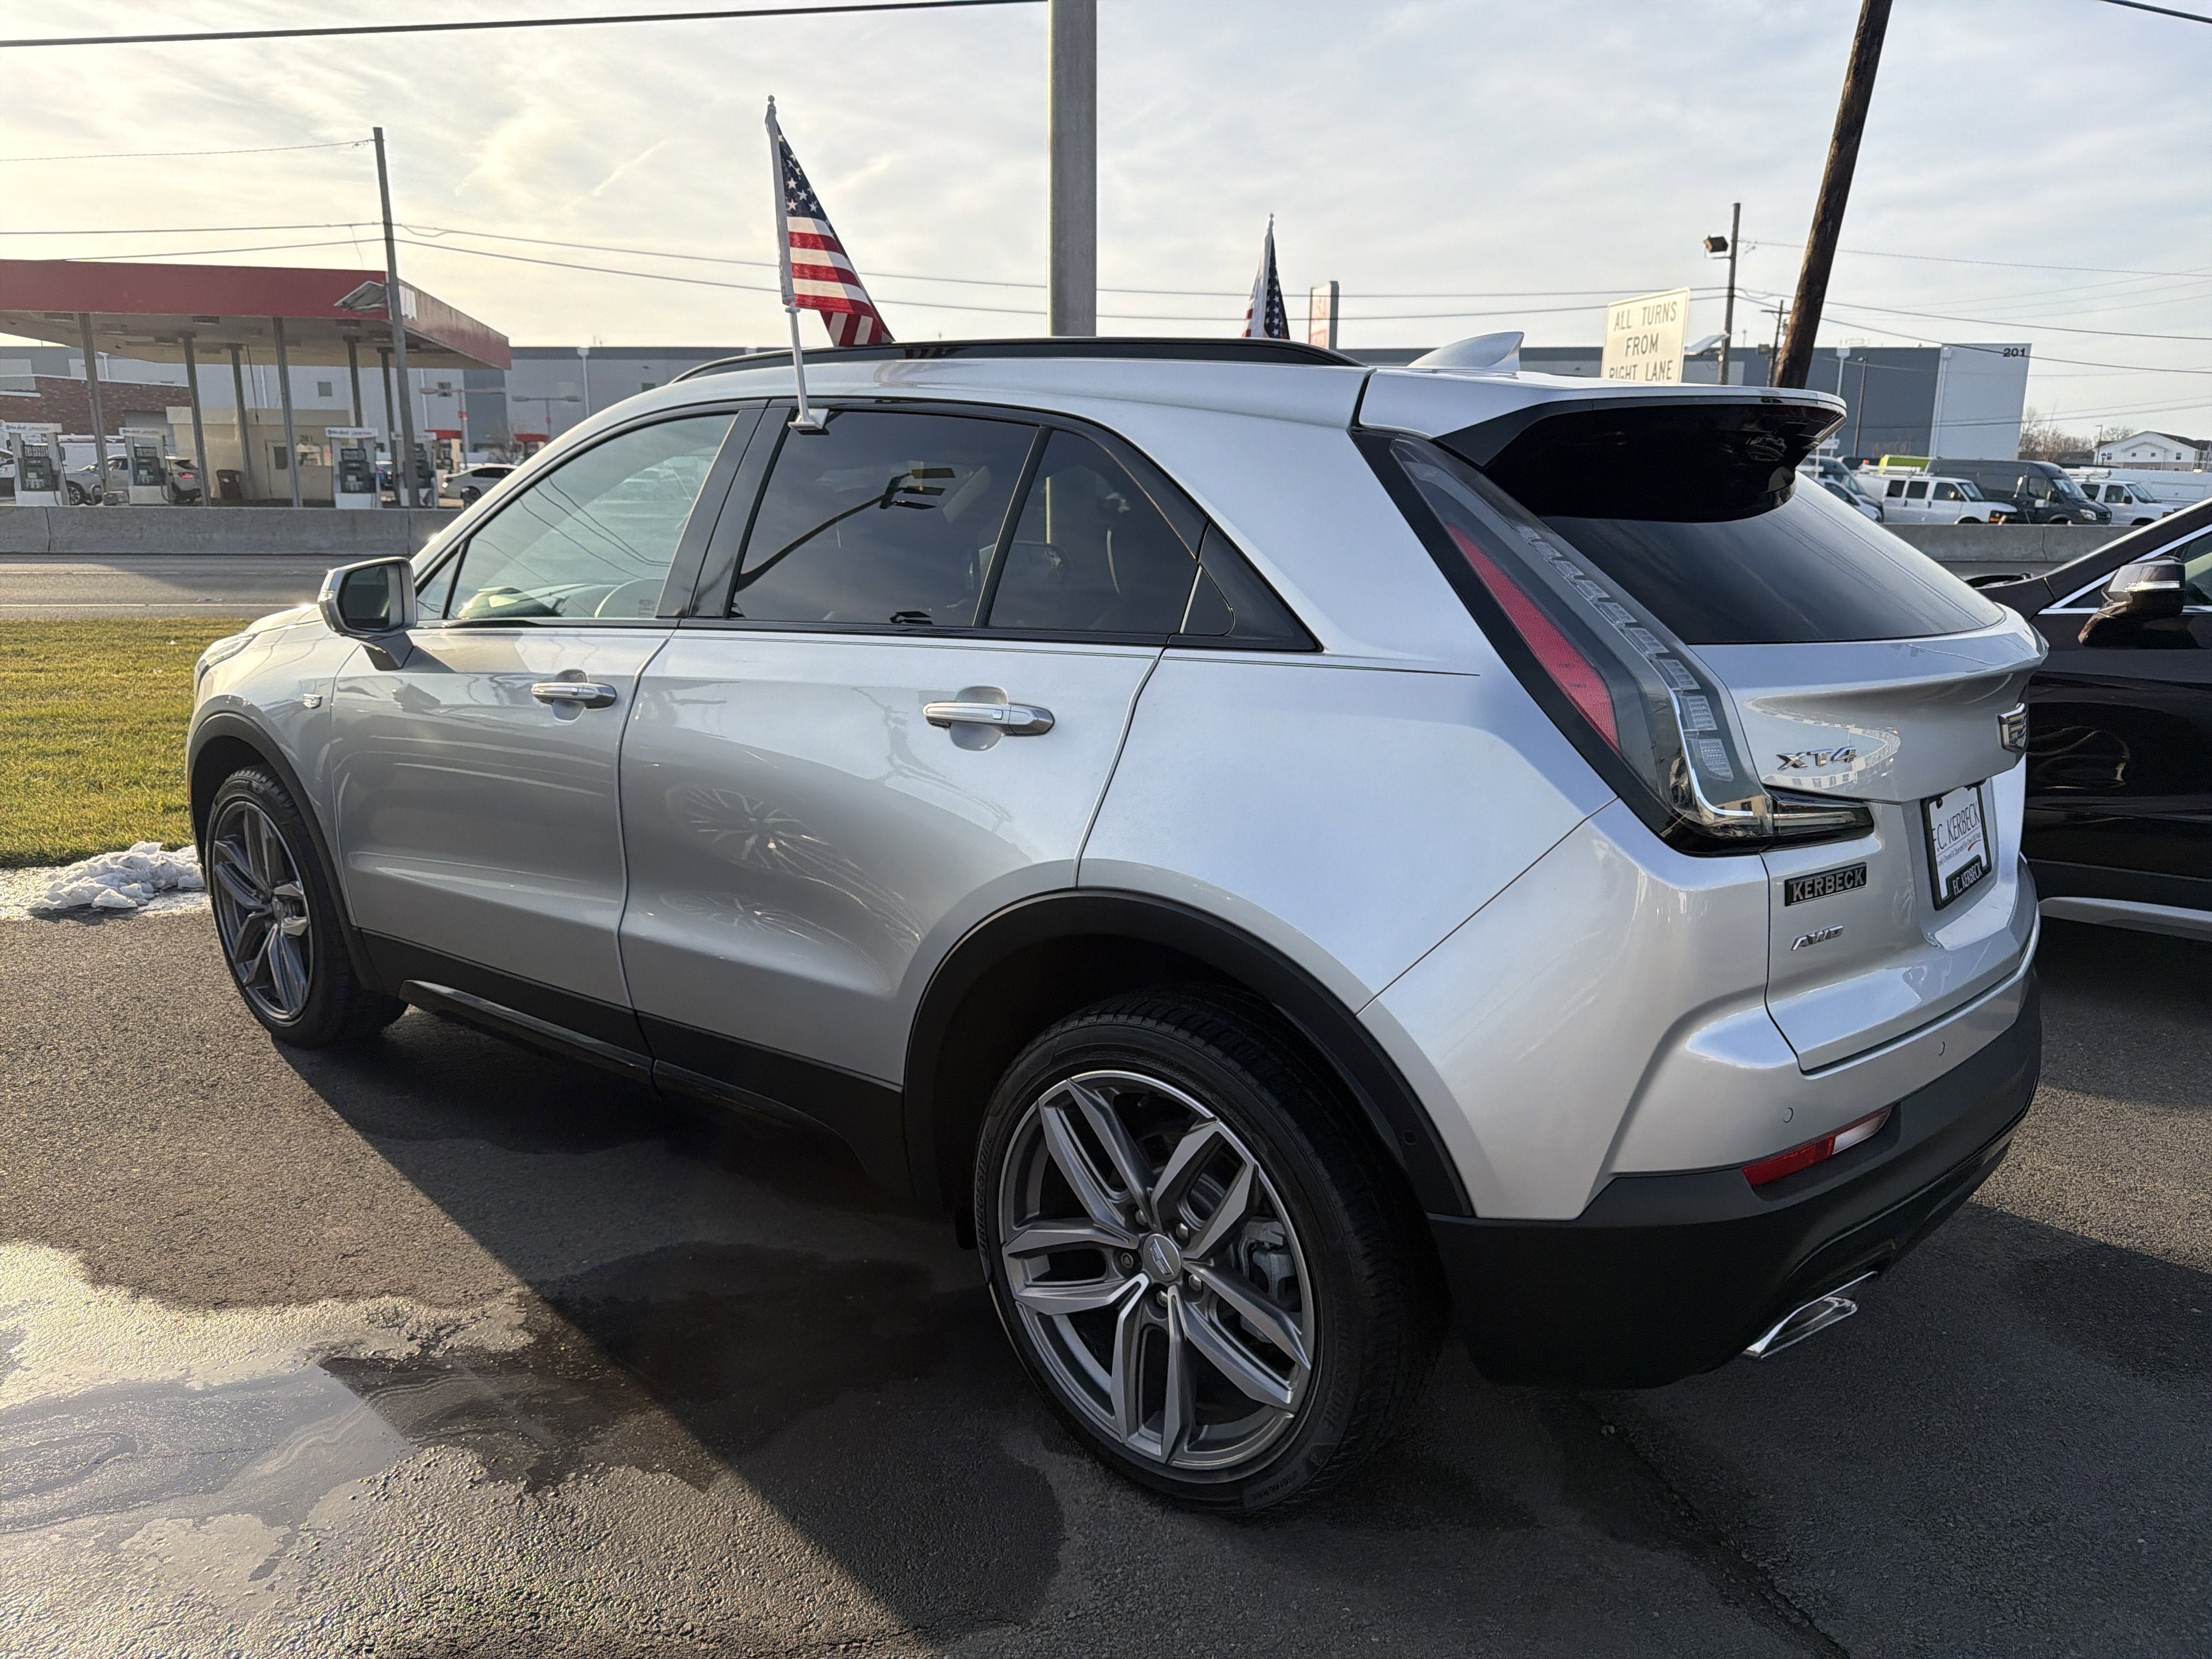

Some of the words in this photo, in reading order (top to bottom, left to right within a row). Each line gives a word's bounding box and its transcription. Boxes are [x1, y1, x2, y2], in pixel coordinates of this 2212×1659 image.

[1613, 309, 1632, 331] ALL
[1642, 301, 1677, 326] TURNS
[1625, 332, 1659, 357] FROM
[2002, 347, 2025, 357] 201
[1645, 359, 1673, 381] LANE
[1776, 746, 1857, 770] XT4
[1947, 801, 1980, 844] KERBECK
[1792, 868, 1865, 901] KERBECK
[1961, 861, 1983, 889] KERBECK
[1791, 924, 1844, 951] AWD
